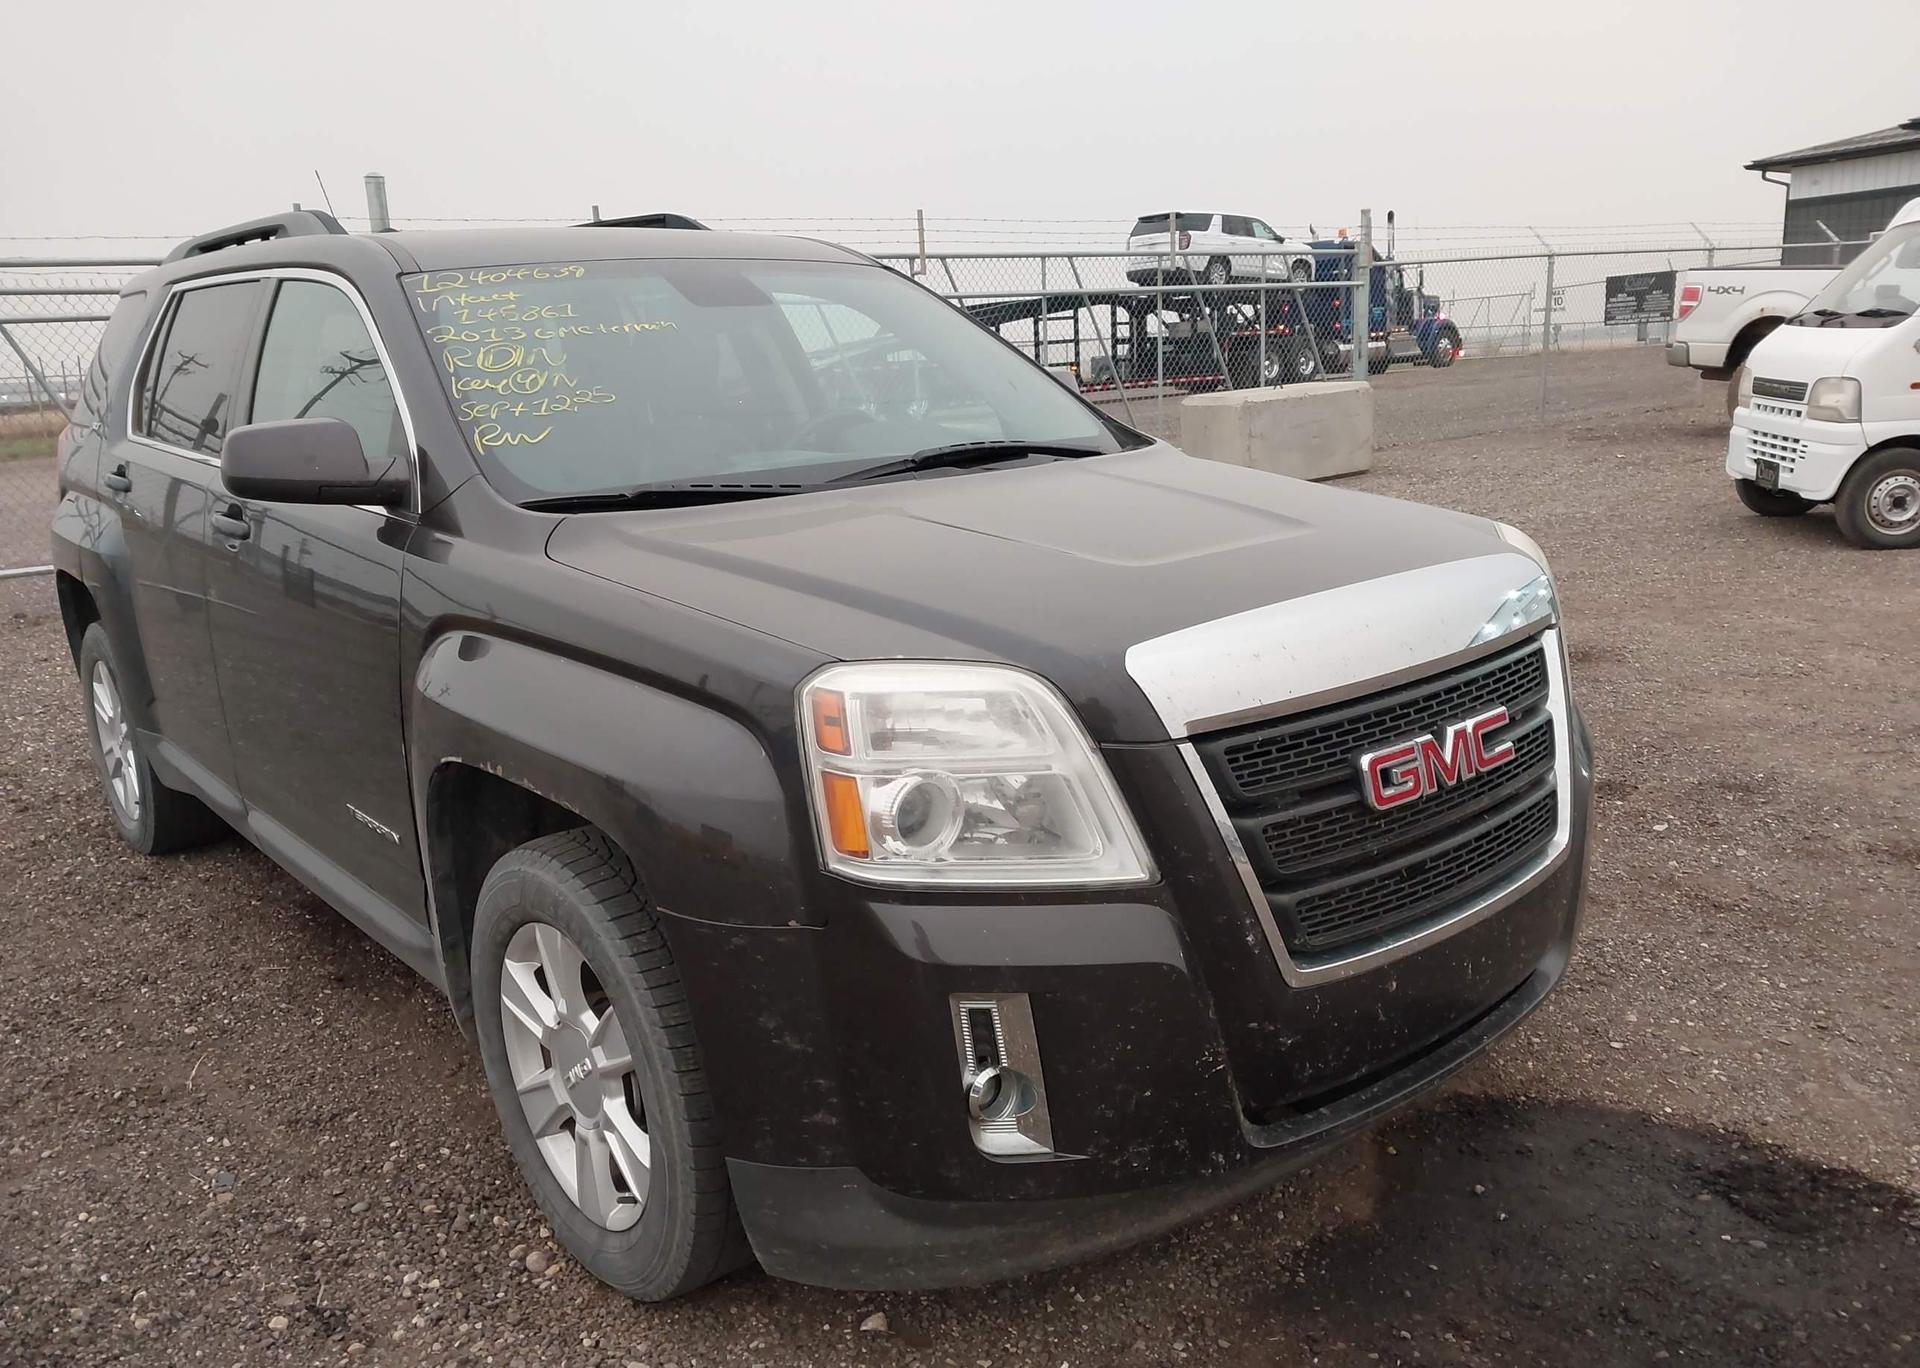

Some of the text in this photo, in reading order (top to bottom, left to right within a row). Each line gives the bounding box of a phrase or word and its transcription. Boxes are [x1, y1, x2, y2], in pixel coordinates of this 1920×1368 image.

[427, 325, 528, 343] 2013
[535, 325, 594, 339] GMC
[1360, 705, 1516, 811] GMC
